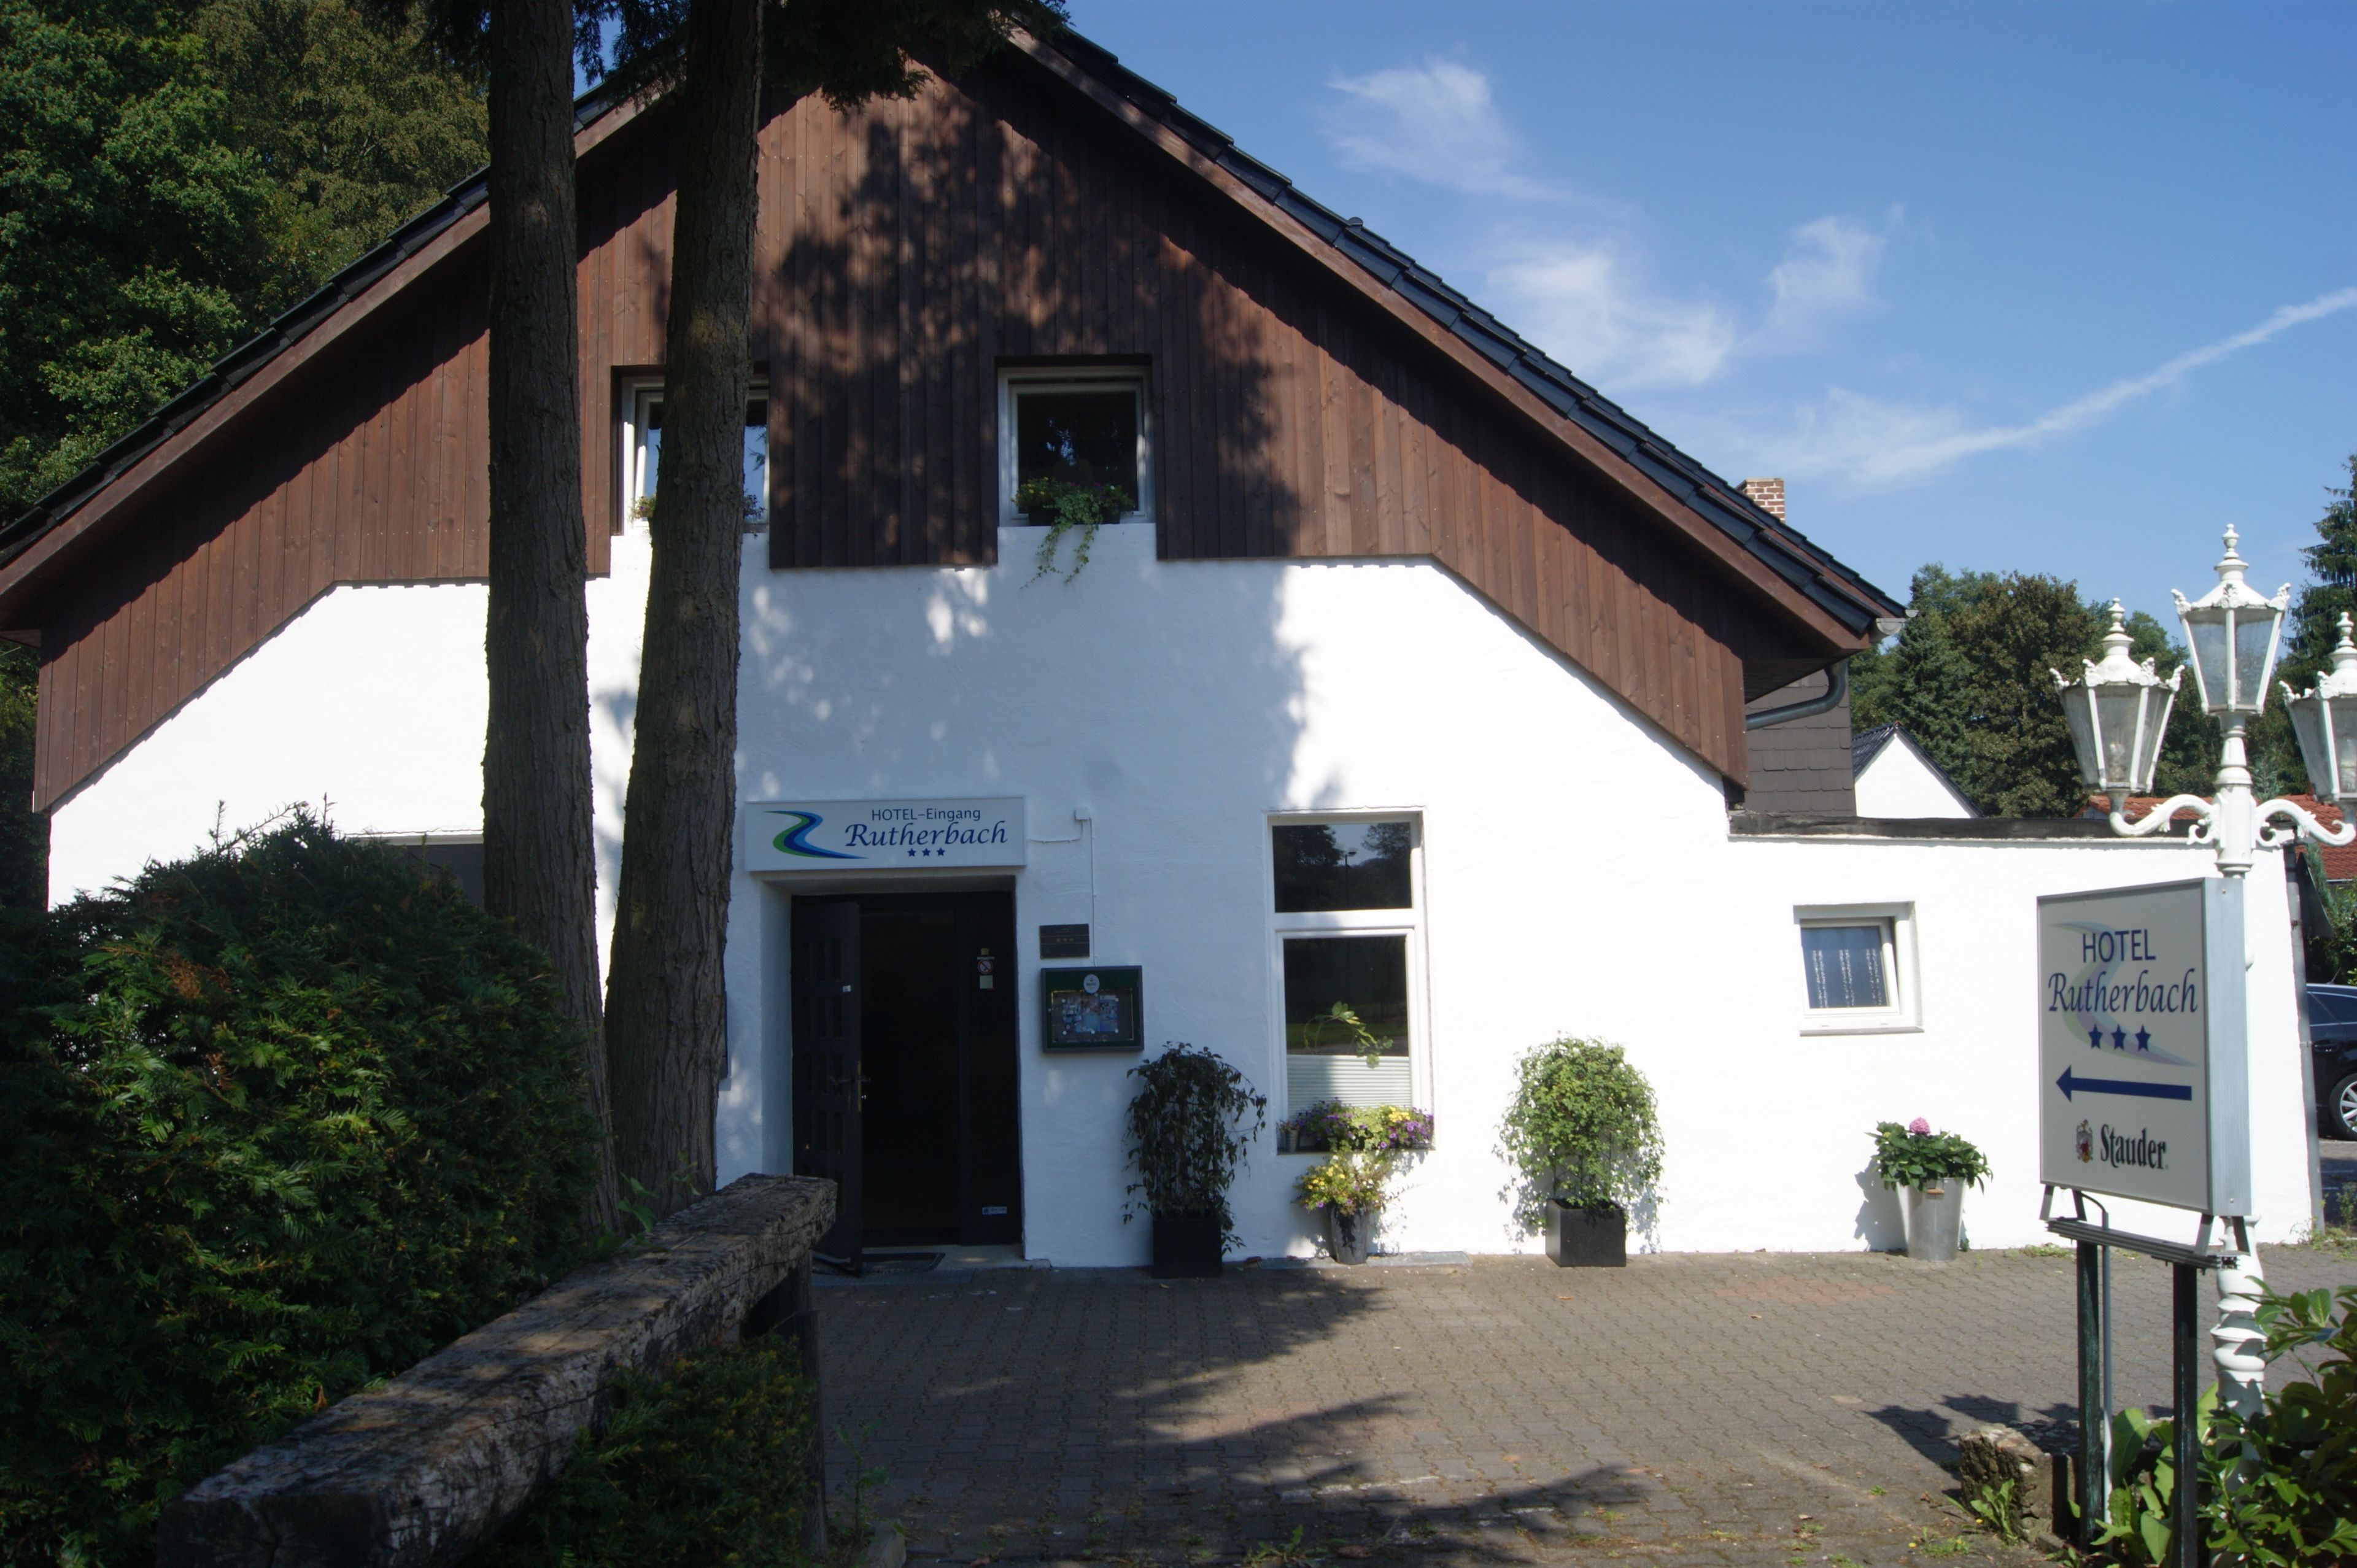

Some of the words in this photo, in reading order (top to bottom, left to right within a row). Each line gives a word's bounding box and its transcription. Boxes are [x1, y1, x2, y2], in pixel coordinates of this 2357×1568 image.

[872, 808, 981, 822] HOTEL-Eingang
[844, 820, 1008, 847] Rutherbach
[2081, 929, 2157, 964] HOTEL
[2047, 967, 2199, 1013] Rutherbach
[2100, 1123, 2167, 1170] Stauder
